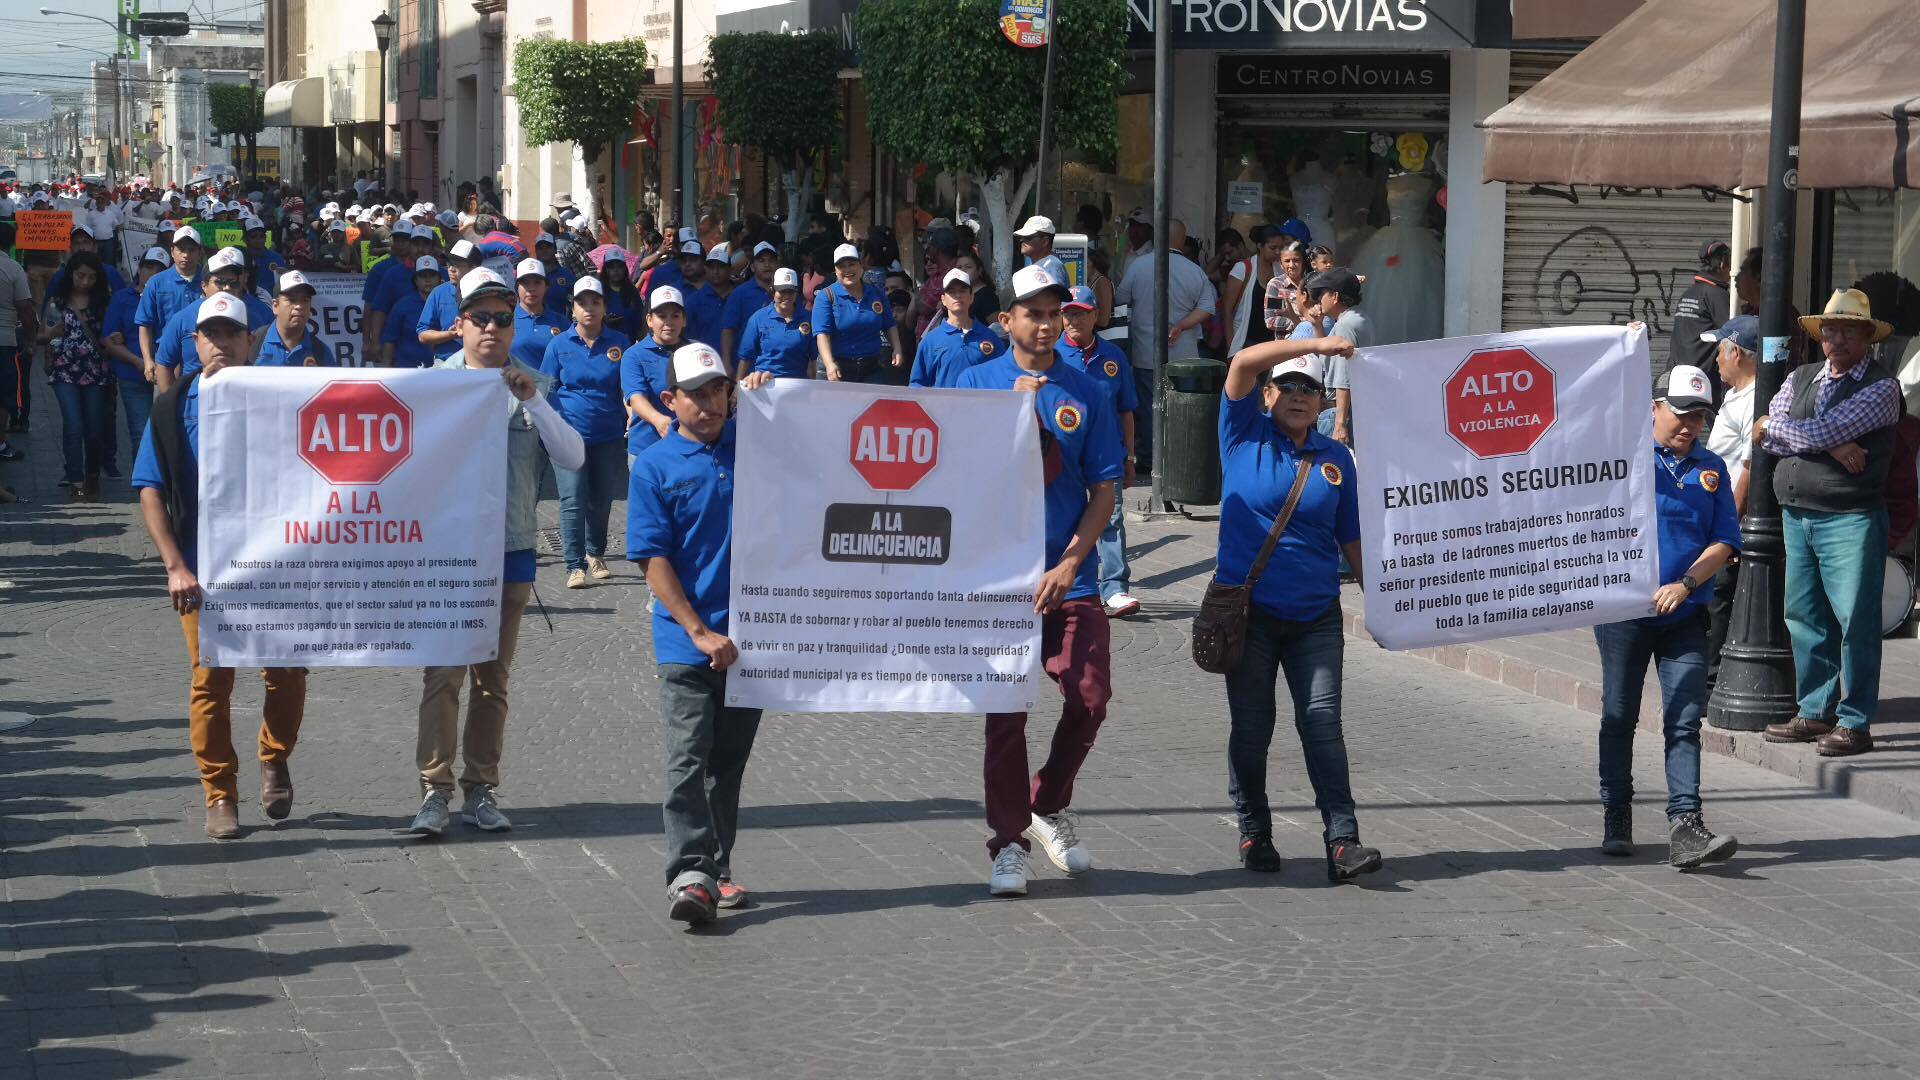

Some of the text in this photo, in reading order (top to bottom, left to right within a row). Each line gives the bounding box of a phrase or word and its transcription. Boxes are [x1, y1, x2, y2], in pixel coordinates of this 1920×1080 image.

[1021, 36, 1042, 44] SMS
[1460, 370, 1533, 398] ALTO
[1483, 400, 1515, 413] A LA
[308, 413, 403, 452] ALTO
[1460, 413, 1541, 433] VIOLENCIA
[855, 426, 934, 463] ALTO
[1384, 459, 1628, 509] EXIGIMOS SEGURIDAD
[326, 491, 382, 513] A LA
[871, 512, 902, 531] A LA
[1393, 506, 1625, 546] Porque somos trabajadores honrados
[284, 520, 423, 544] INJUSTICIA
[829, 534, 942, 558] DELINCUENCIA
[1381, 527, 1638, 572] ya basta de ladrones muertos de hambre
[230, 557, 477, 571] Nosotros la raza obrera exigimos apoyo al presidente
[1380, 549, 1643, 592] señor presidente municipal escucha la voz
[260, 581, 276, 589] con
[279, 581, 290, 589] un
[294, 580, 320, 591] mejor
[324, 579, 360, 589] servicio
[363, 580, 368, 590] y
[372, 579, 410, 589] atención
[413, 580, 424, 588] en
[427, 579, 436, 588] el
[439, 579, 469, 590] seguro
[473, 578, 497, 587] social
[741, 584, 1032, 603] Hasta cuando seguiremos soportando tanta delincuencia
[1395, 572, 1630, 612] del pueblo que te pide seguridad para
[205, 600, 247, 612] Exigimos
[326, 602, 343, 611] que
[346, 600, 354, 609] el
[357, 600, 385, 609] sector
[389, 599, 413, 609] salud
[416, 601, 427, 610] ya
[430, 600, 440, 608] no
[444, 598, 457, 608] los
[1436, 600, 1594, 629] toda la familia celayanse
[218, 622, 232, 632] por
[236, 622, 252, 631] eso
[255, 621, 295, 631] estamos
[298, 621, 337, 632] pagando
[340, 621, 351, 630] un
[354, 620, 391, 630] servicio
[394, 620, 404, 629] de
[408, 619, 447, 629] atención
[450, 619, 458, 628] al
[738, 612, 1033, 629] YA BASTA de sobornar y robar al pueblo tenemos derecho
[294, 641, 414, 652] por que nada es regalado.
[741, 640, 1030, 657] de vivir en paz y tranquilidad ¿Donde esta la seguridad?
[740, 668, 1028, 684] autoridad municipal ya es tiempo de ponerse a trabajar.
